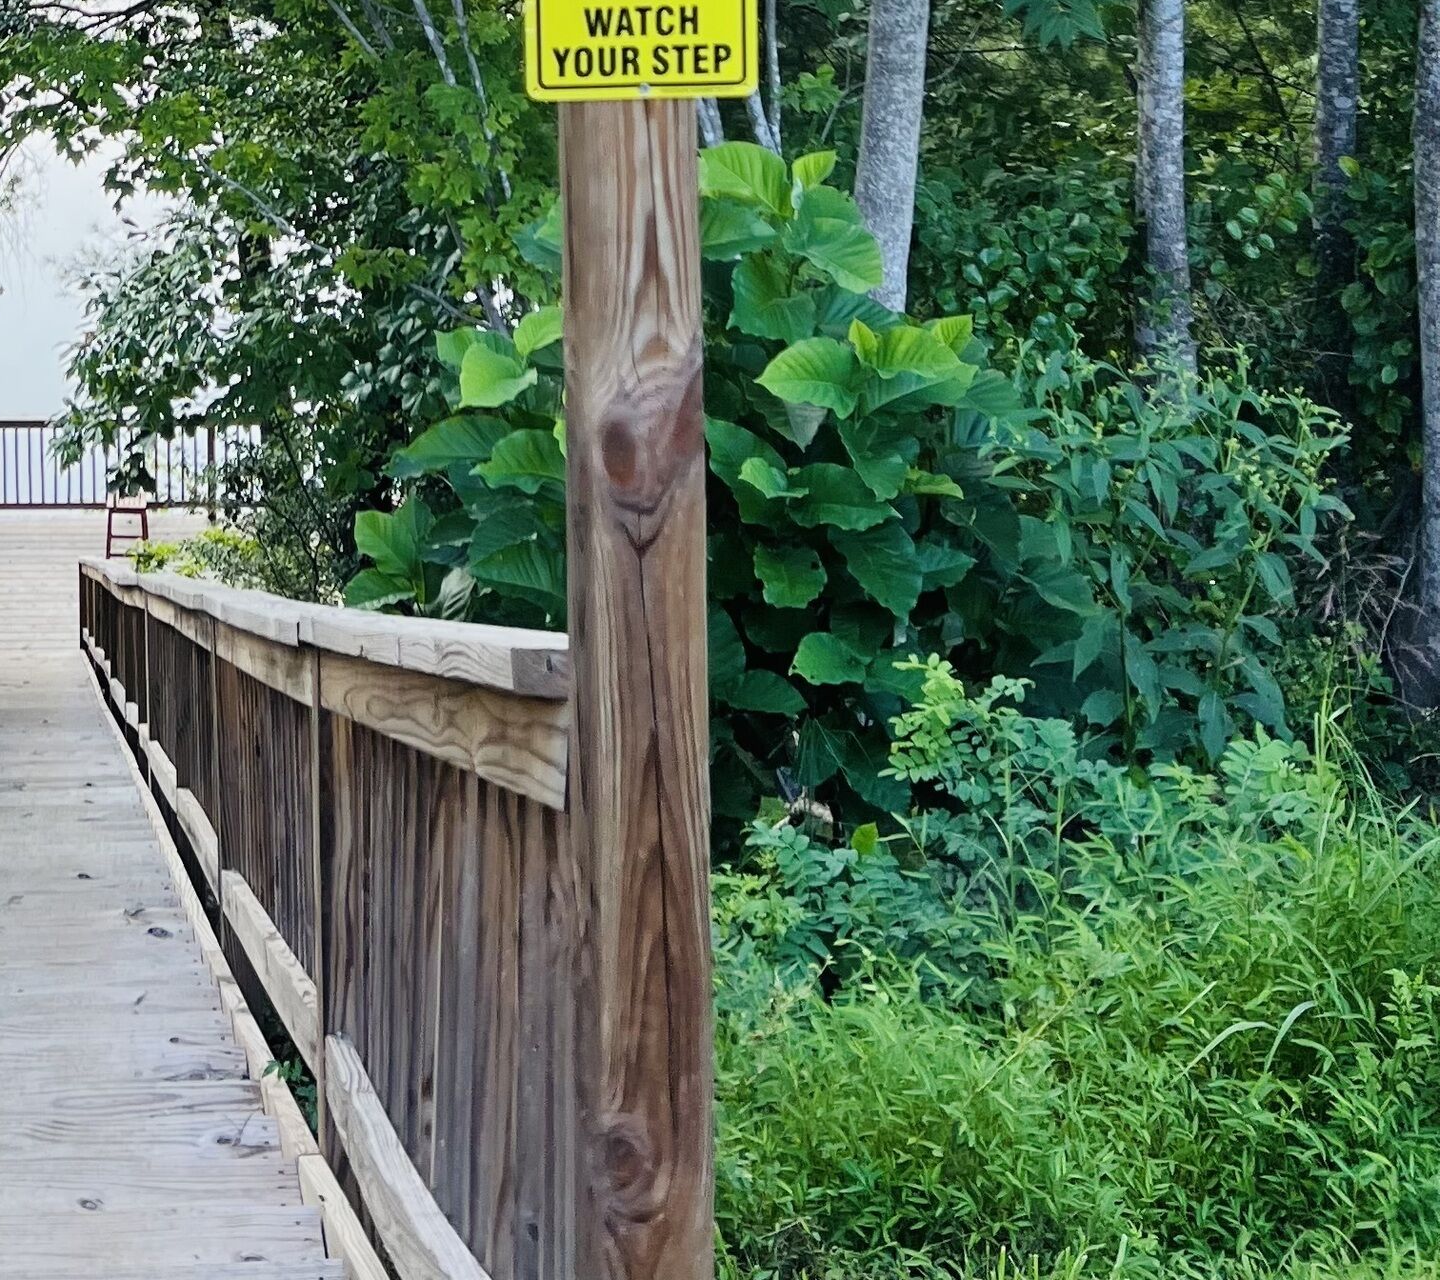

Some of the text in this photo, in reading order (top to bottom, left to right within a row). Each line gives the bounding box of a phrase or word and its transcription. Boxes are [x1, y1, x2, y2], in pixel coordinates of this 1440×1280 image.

[583, 6, 699, 38] WATCH
[552, 43, 733, 78] YOUR STEP
